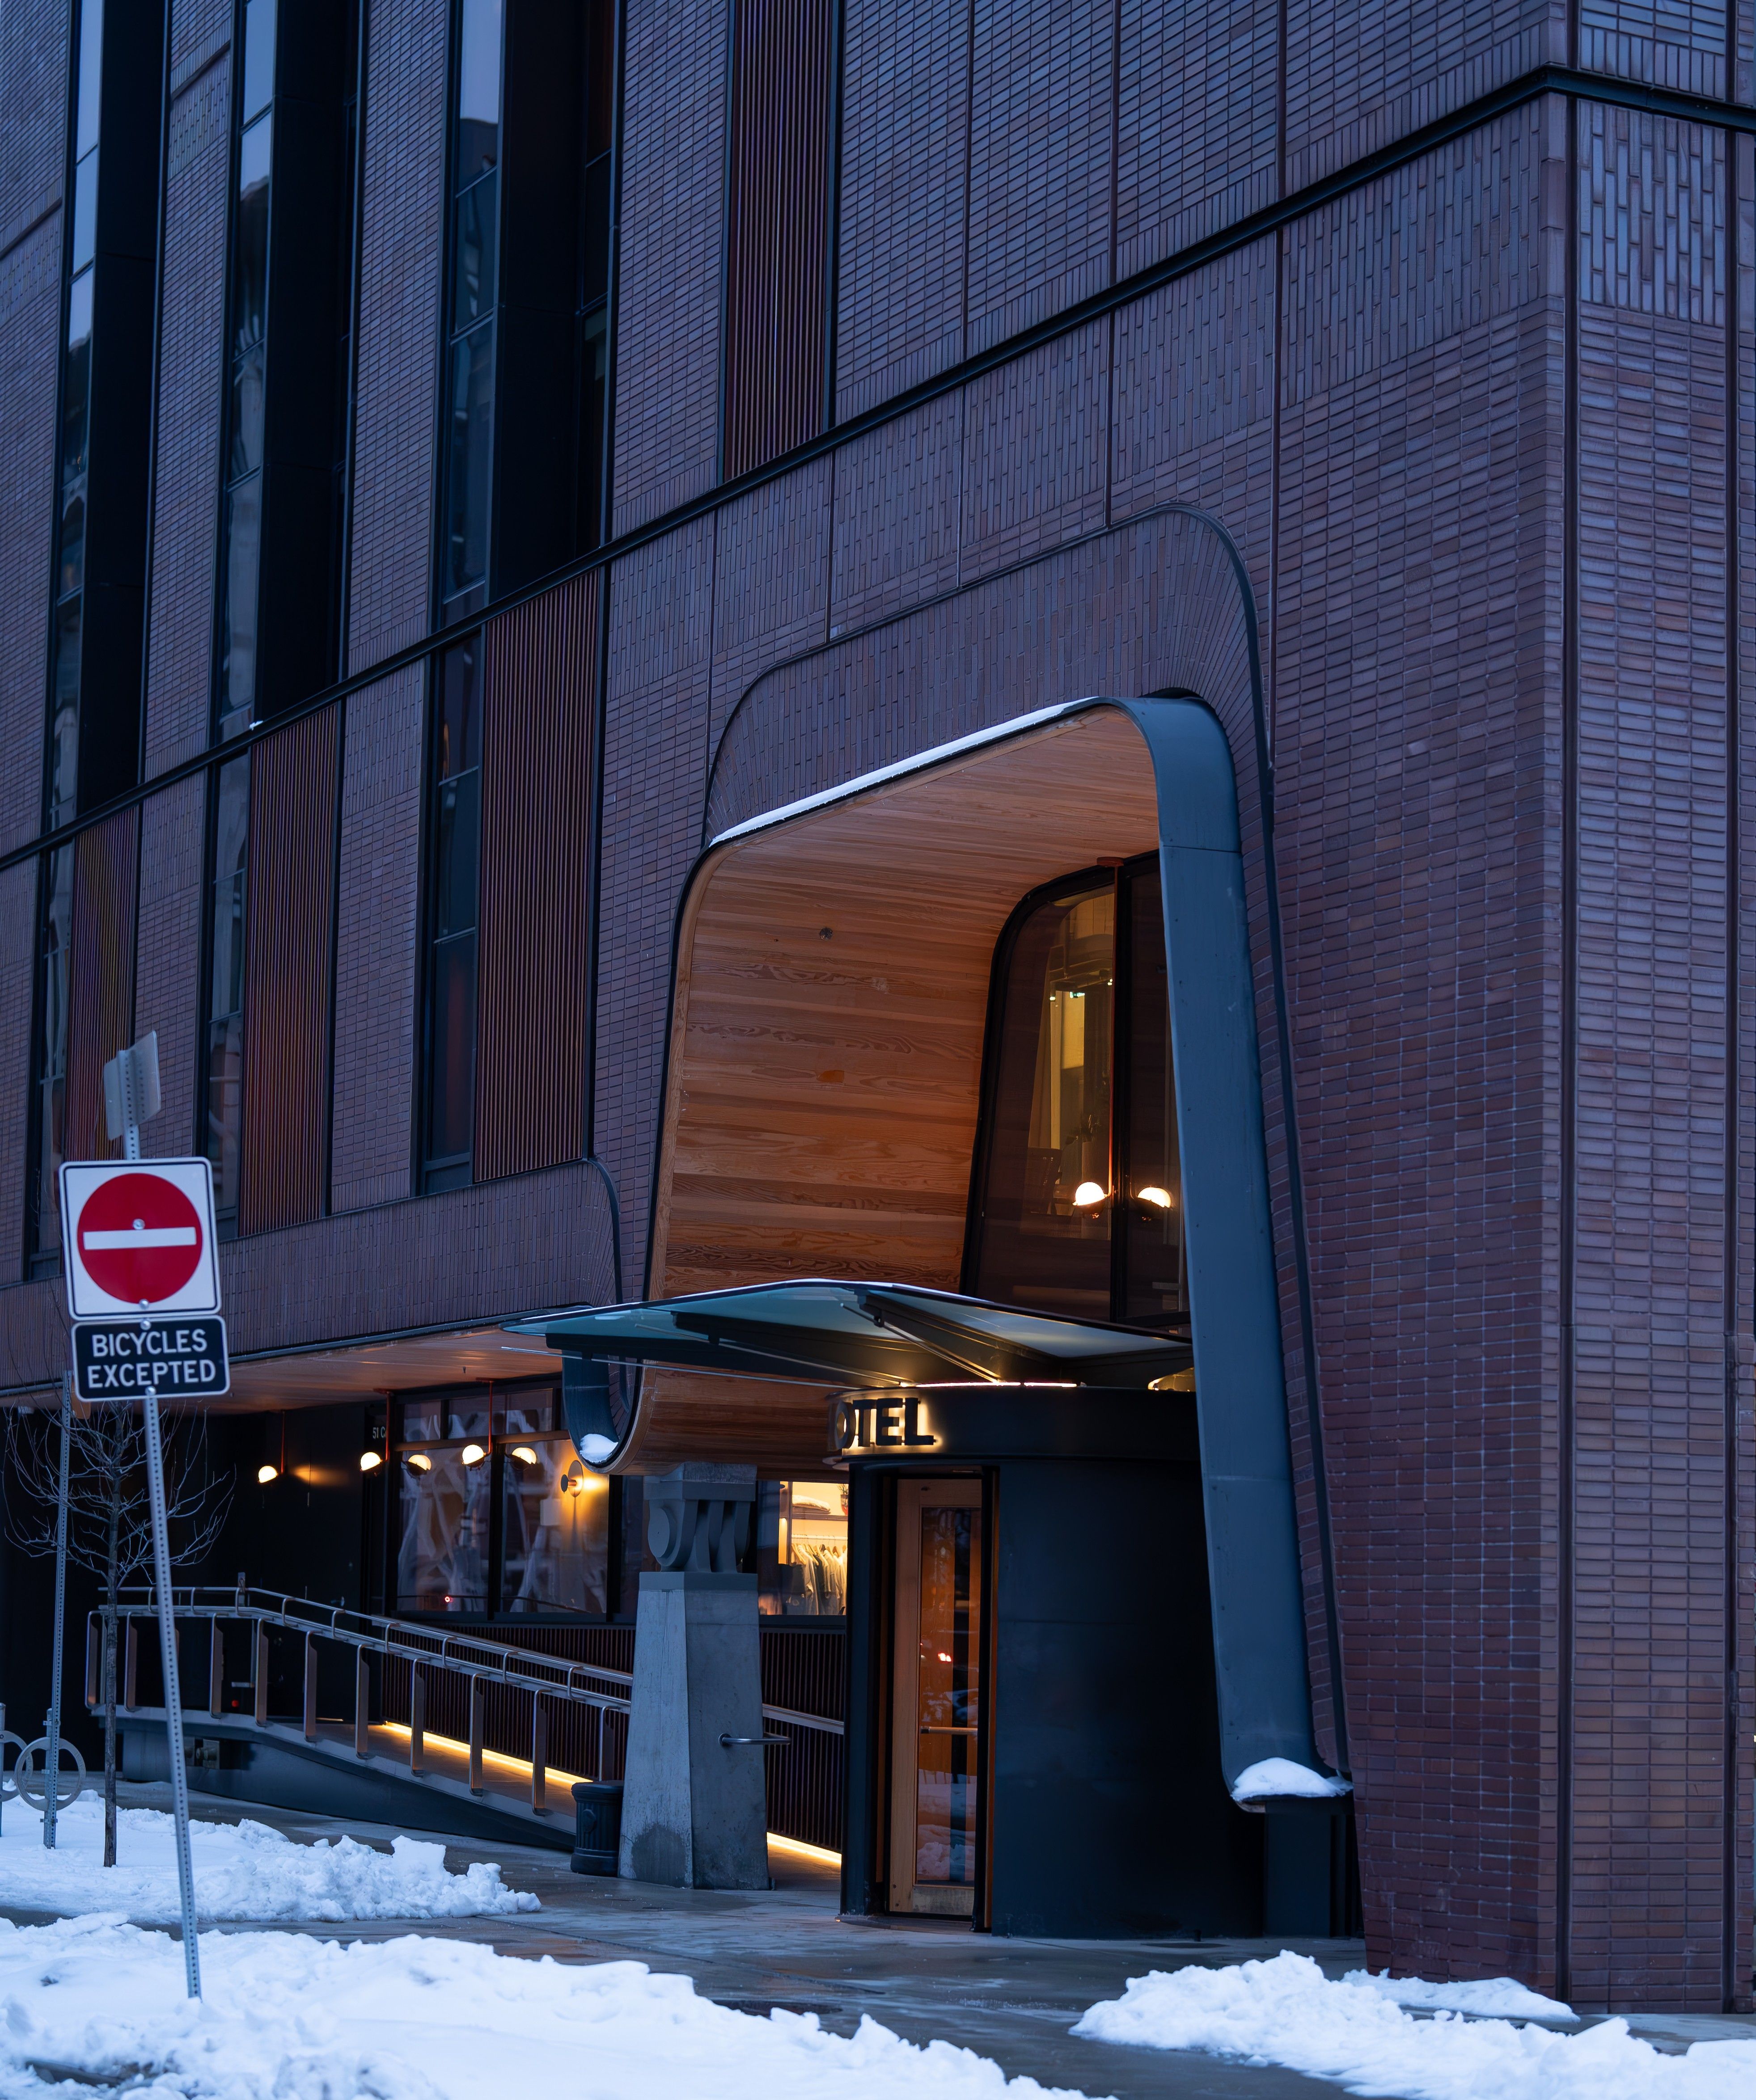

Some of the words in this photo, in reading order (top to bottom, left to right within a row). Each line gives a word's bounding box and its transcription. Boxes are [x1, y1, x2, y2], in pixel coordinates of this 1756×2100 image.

[92, 1329, 207, 1358] BICYCLES
[87, 1359, 216, 1389] EXCEPTED
[834, 1397, 934, 1450] OTEL
